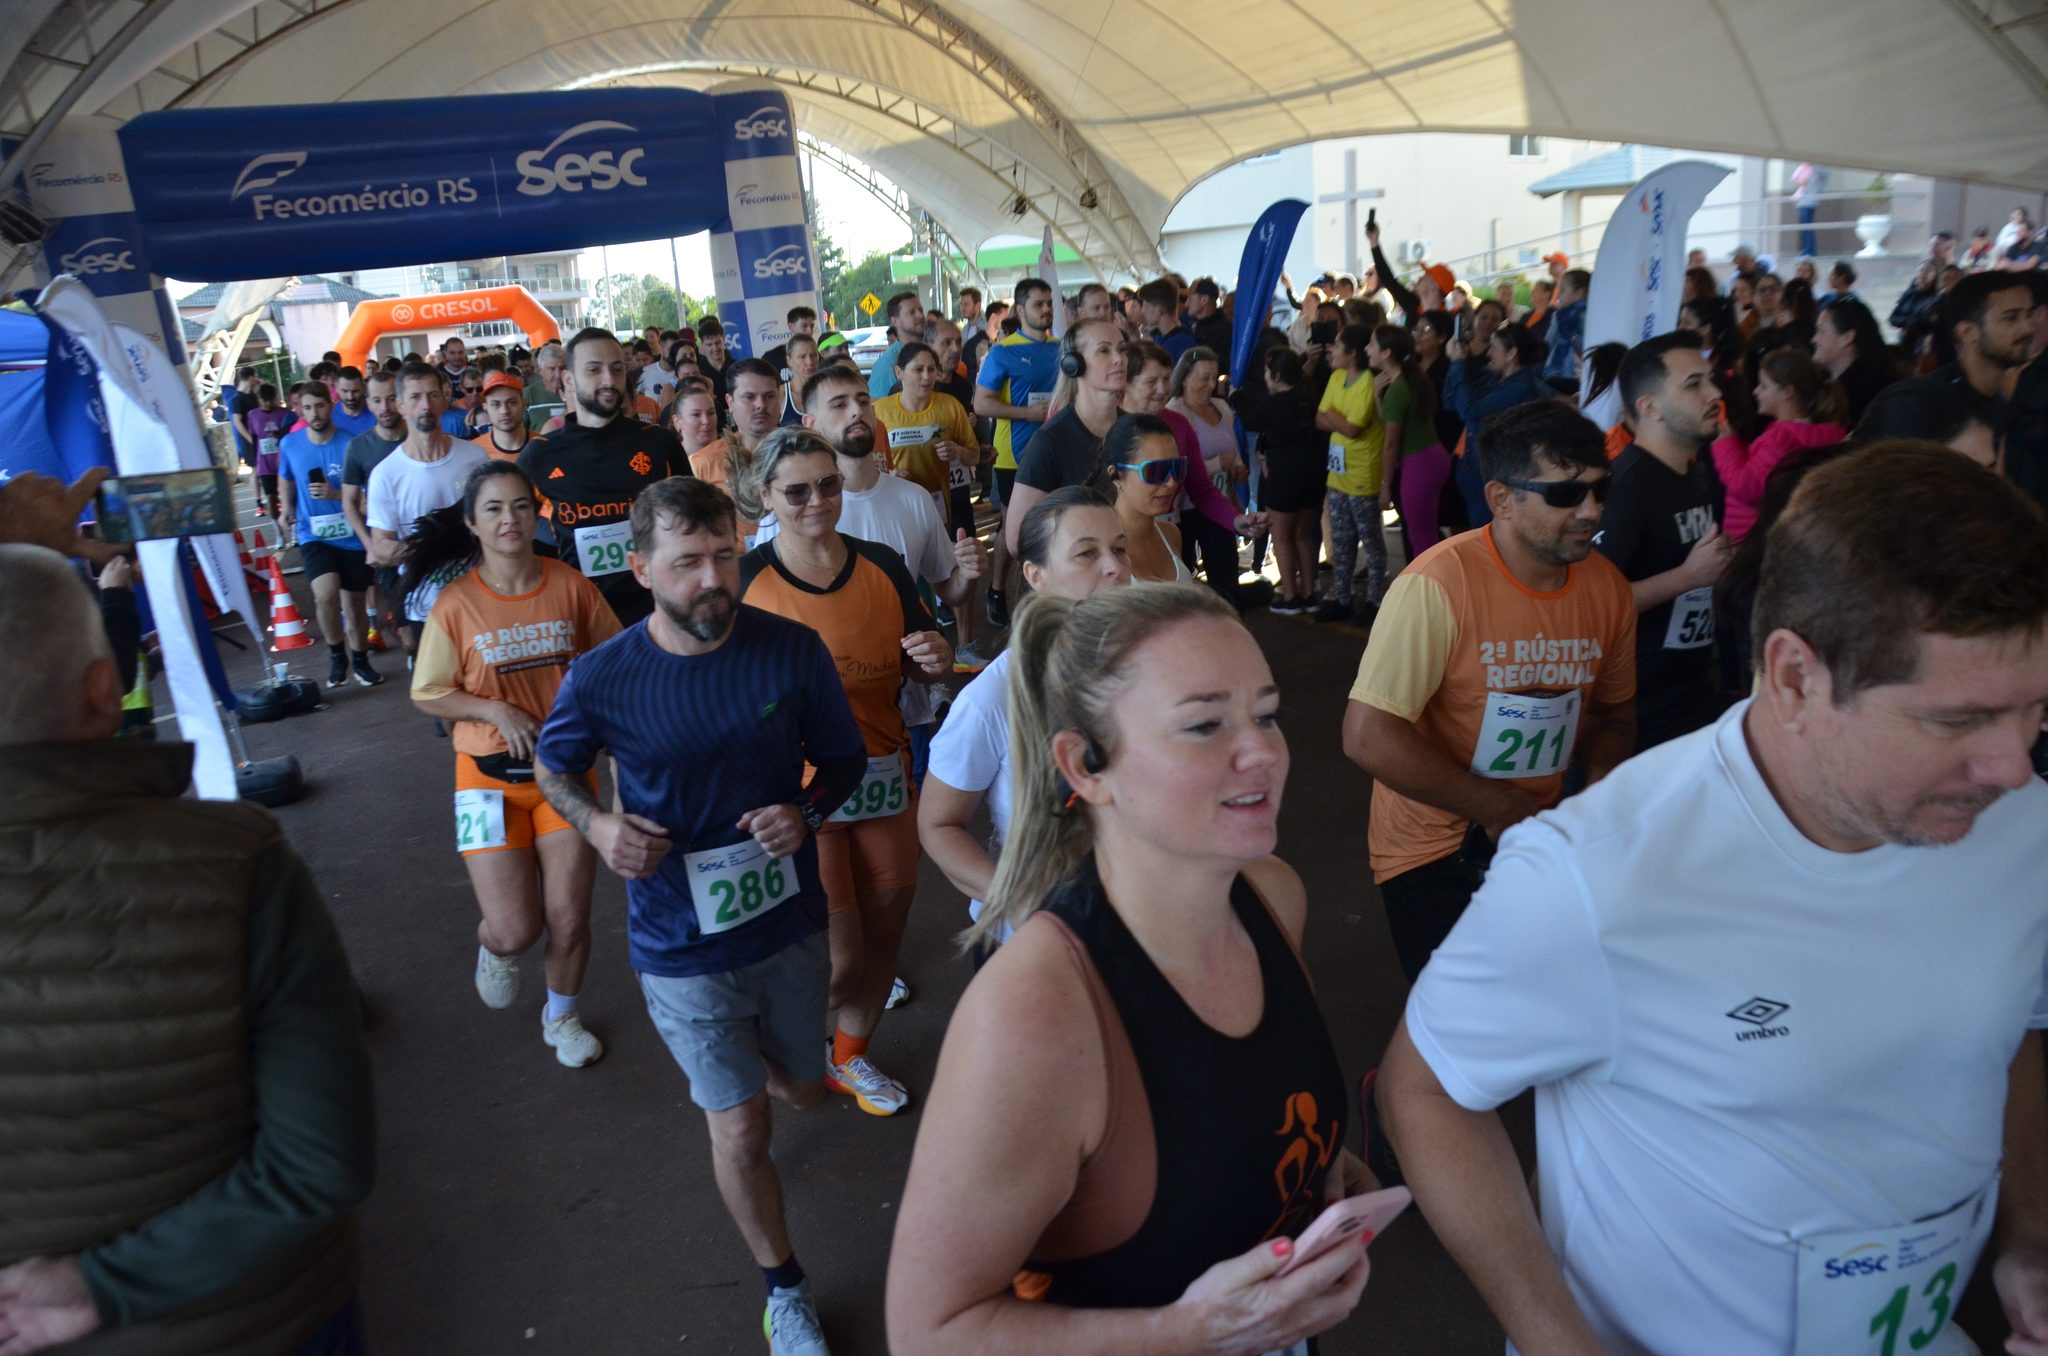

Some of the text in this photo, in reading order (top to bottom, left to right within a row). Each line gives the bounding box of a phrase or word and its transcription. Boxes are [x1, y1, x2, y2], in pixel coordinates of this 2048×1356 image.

[735, 114, 788, 140] Sesc
[515, 138, 648, 196] Sesc
[252, 177, 478, 220] Fecomércio RS
[60, 247, 136, 276] Sesc
[753, 251, 807, 279] Sesc
[419, 297, 498, 319] CRESOL
[762, 332, 792, 342] Fecom
[576, 497, 633, 519] banri
[318, 522, 348, 538] 225
[497, 620, 576, 645] RÚSTICA
[1678, 608, 1713, 643] 52
[482, 636, 575, 665] REGIONAL
[1514, 632, 1603, 664] RÚSTICA
[1486, 662, 1596, 689] REGIONAL
[1497, 705, 1528, 719] Sesc
[1488, 724, 1567, 772] 211
[842, 774, 903, 817] 395
[457, 810, 490, 845] 21
[697, 859, 728, 873] Sesc
[709, 857, 785, 925] 286
[1735, 1026, 1790, 1042] umbro
[1823, 1254, 1890, 1279] Sesc
[1868, 1261, 1958, 1356] 13
